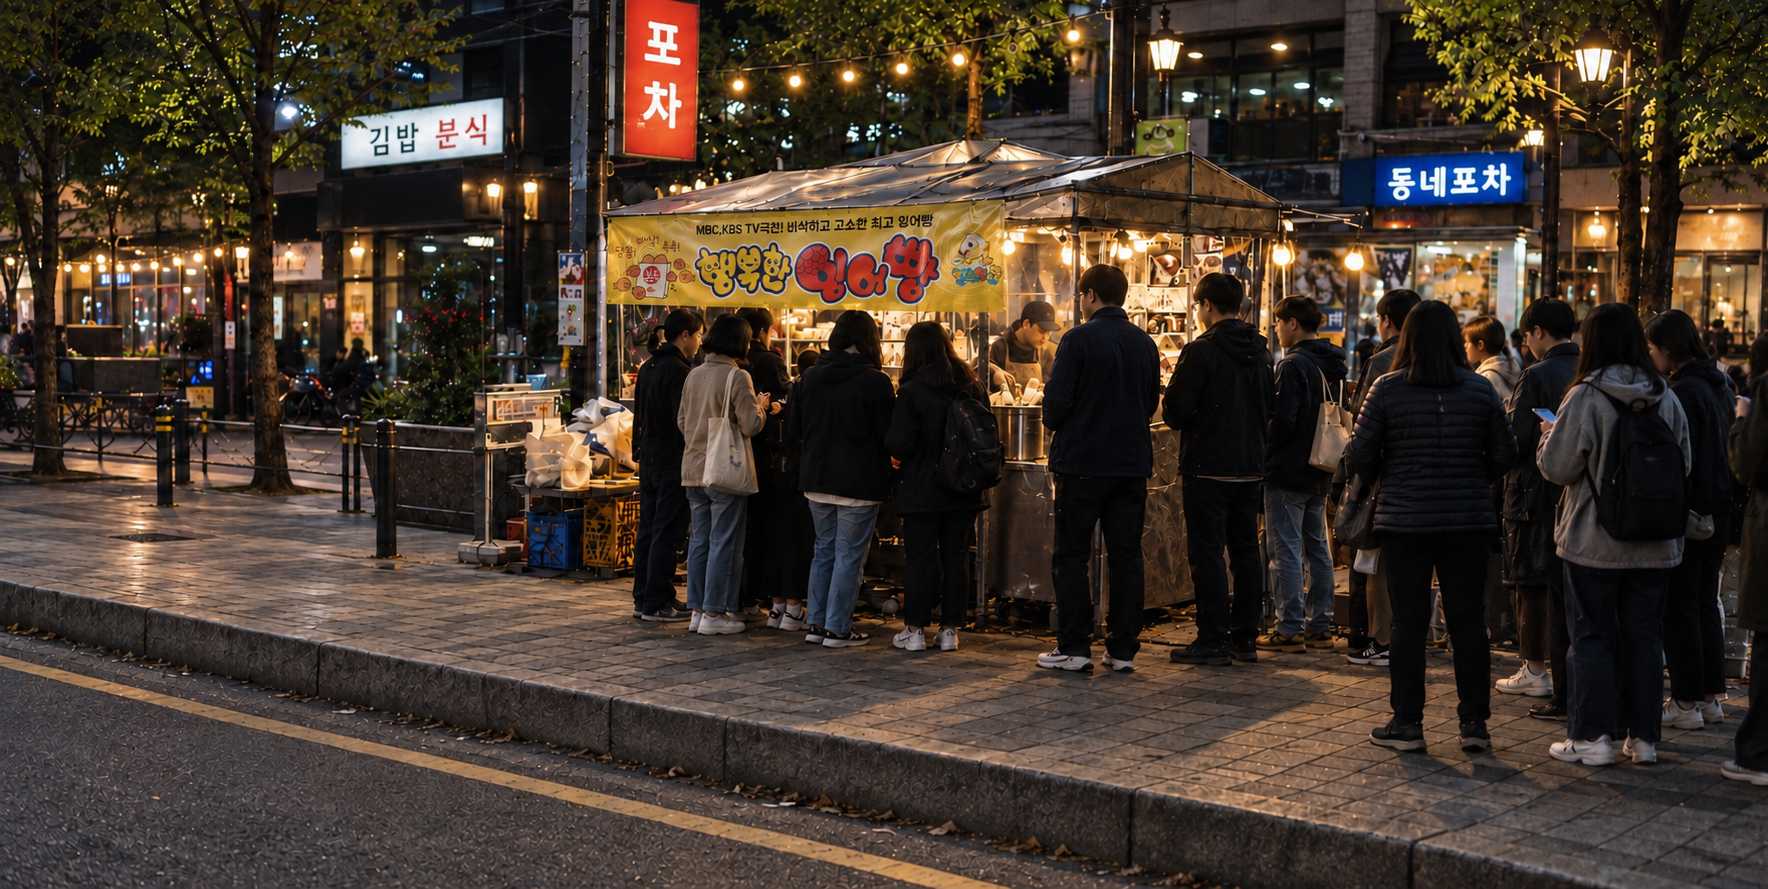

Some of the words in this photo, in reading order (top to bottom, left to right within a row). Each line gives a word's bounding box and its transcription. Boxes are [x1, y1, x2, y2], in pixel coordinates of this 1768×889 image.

[642, 20, 682, 129] 포차
[370, 122, 419, 157] 김밥
[435, 114, 487, 149] 분식
[1388, 163, 1512, 200] 동네포차
[696, 224, 743, 236] MBC,KBS
[694, 241, 793, 299] 행복한
[794, 233, 942, 305] 잉어빵
